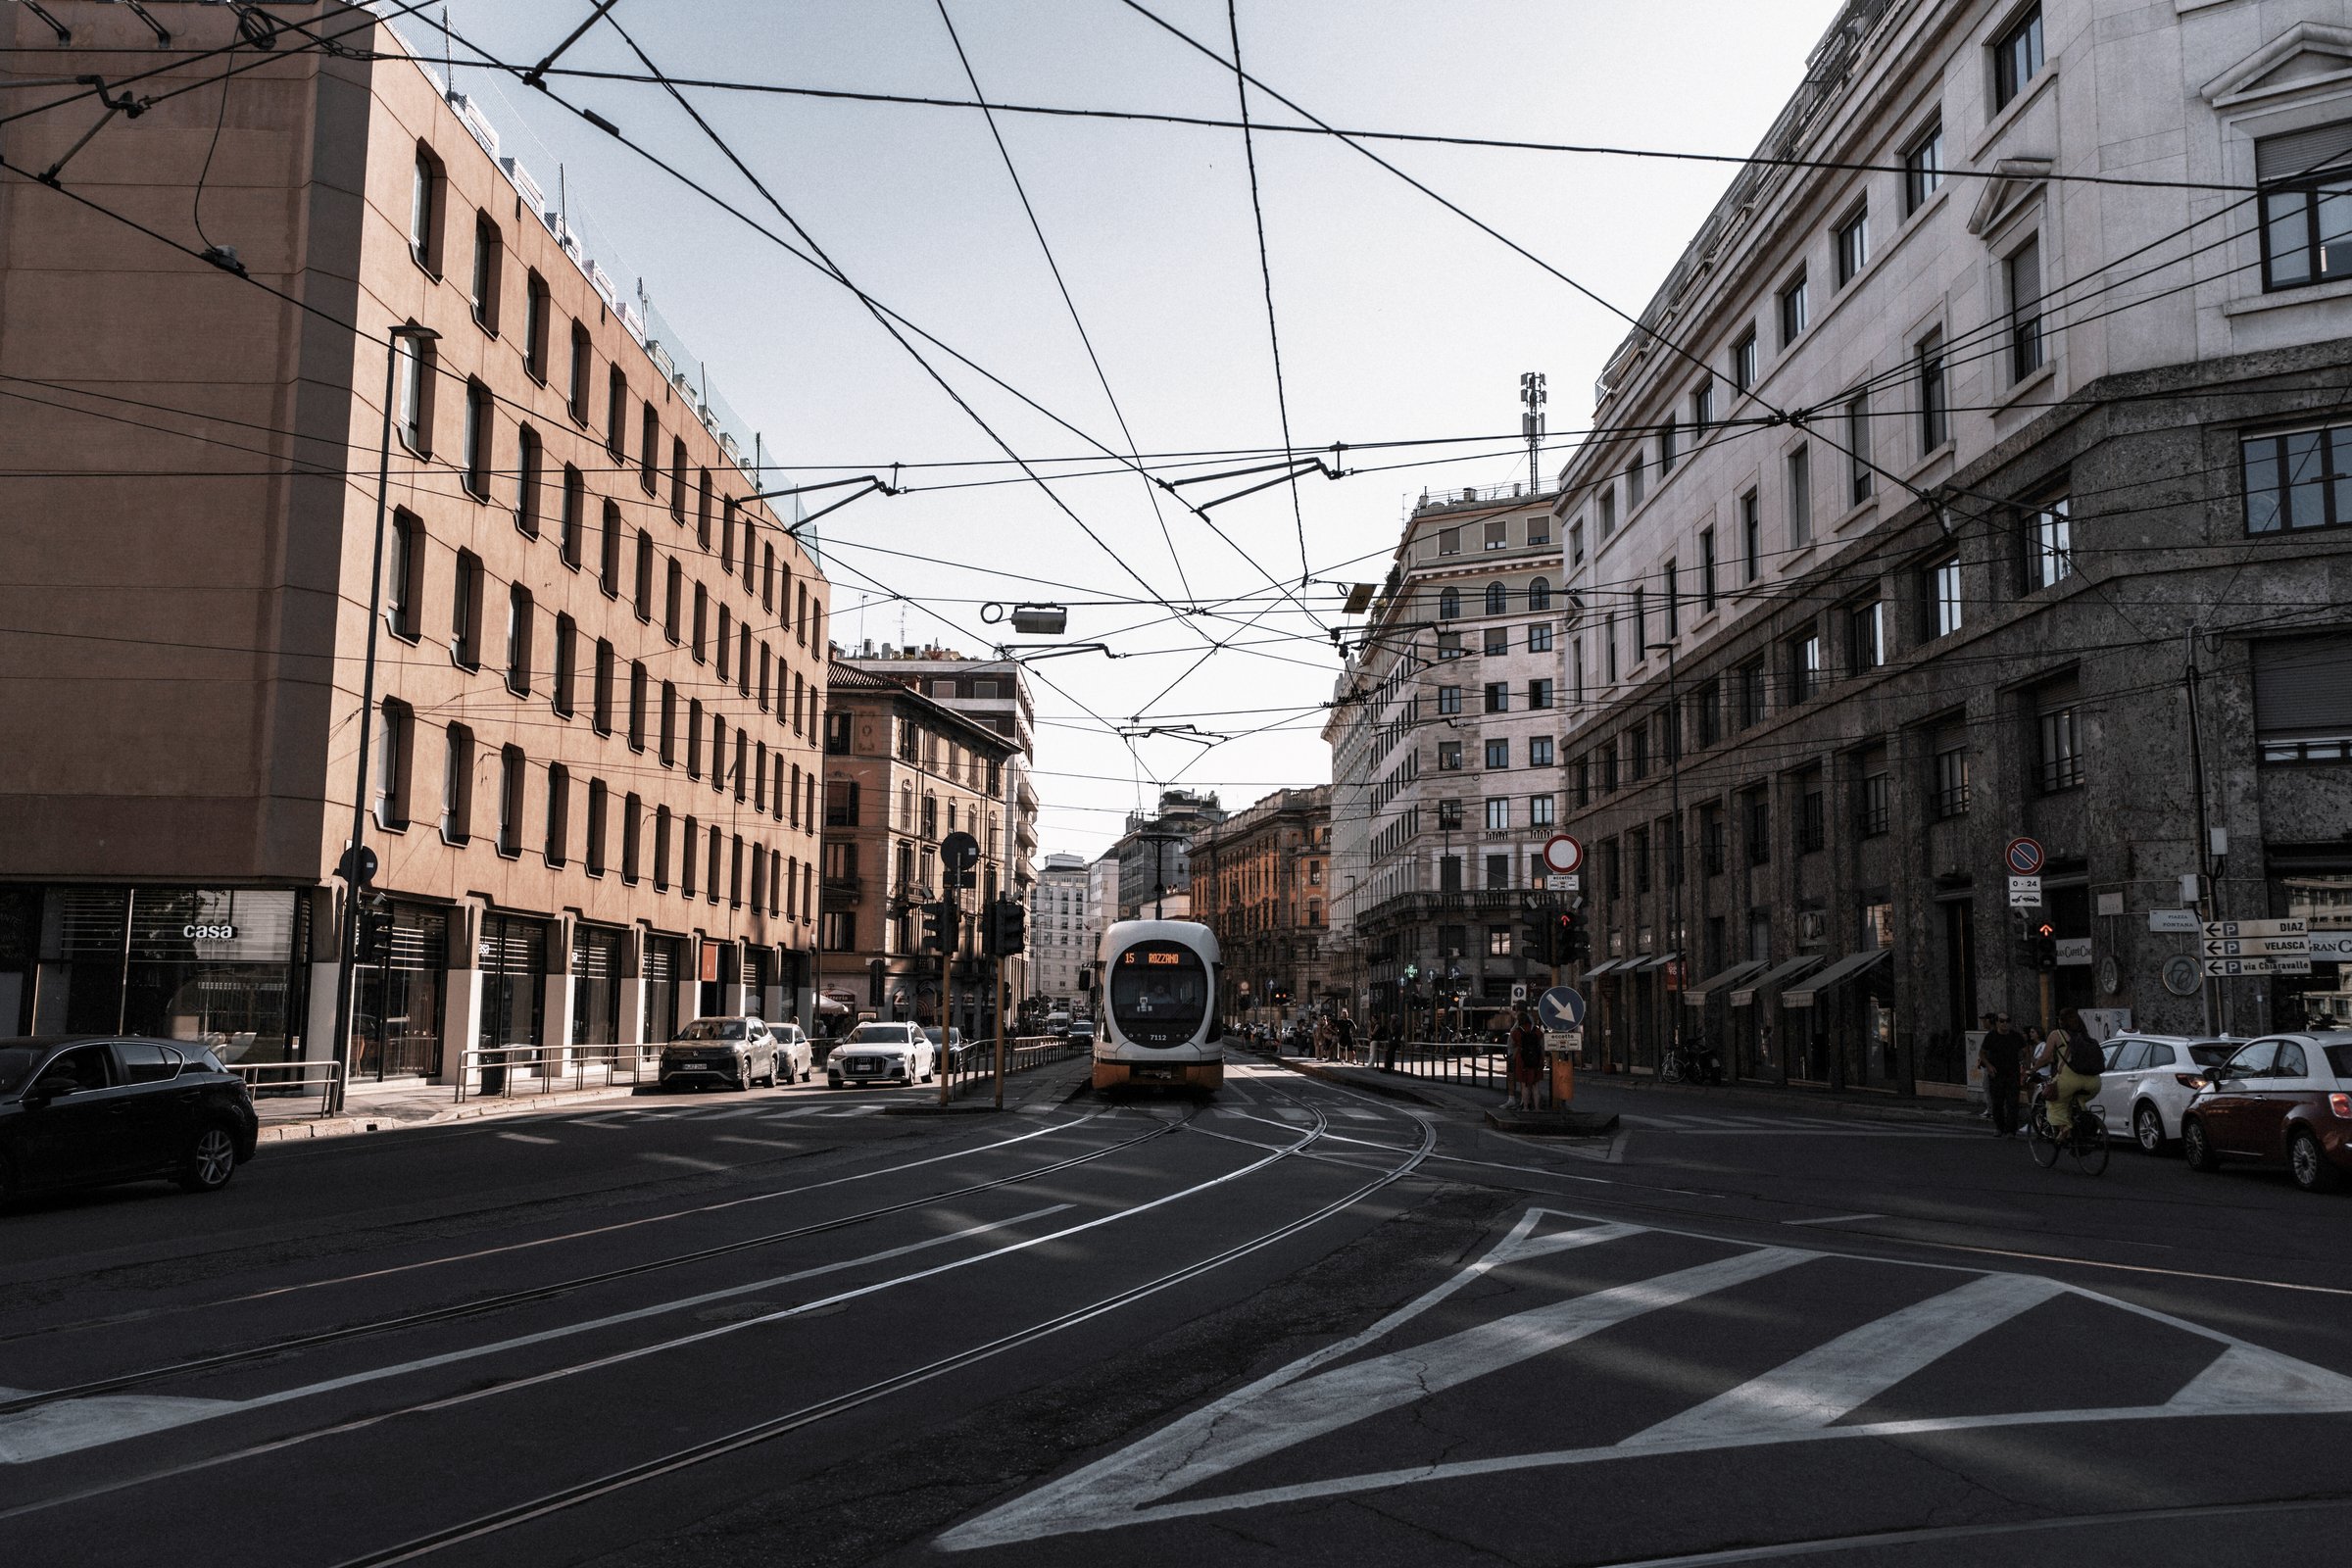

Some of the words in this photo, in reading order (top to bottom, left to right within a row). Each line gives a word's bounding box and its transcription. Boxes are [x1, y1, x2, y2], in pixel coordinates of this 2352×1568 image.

[183, 924, 232, 939] casa
[2279, 922, 2304, 932] DIAZ
[478, 944, 489, 955] asa
[2265, 941, 2305, 951] VELASCA
[1124, 953, 1135, 963] 15
[1149, 953, 1179, 964] ROZZANO
[2259, 960, 2309, 970] Chiaravalle
